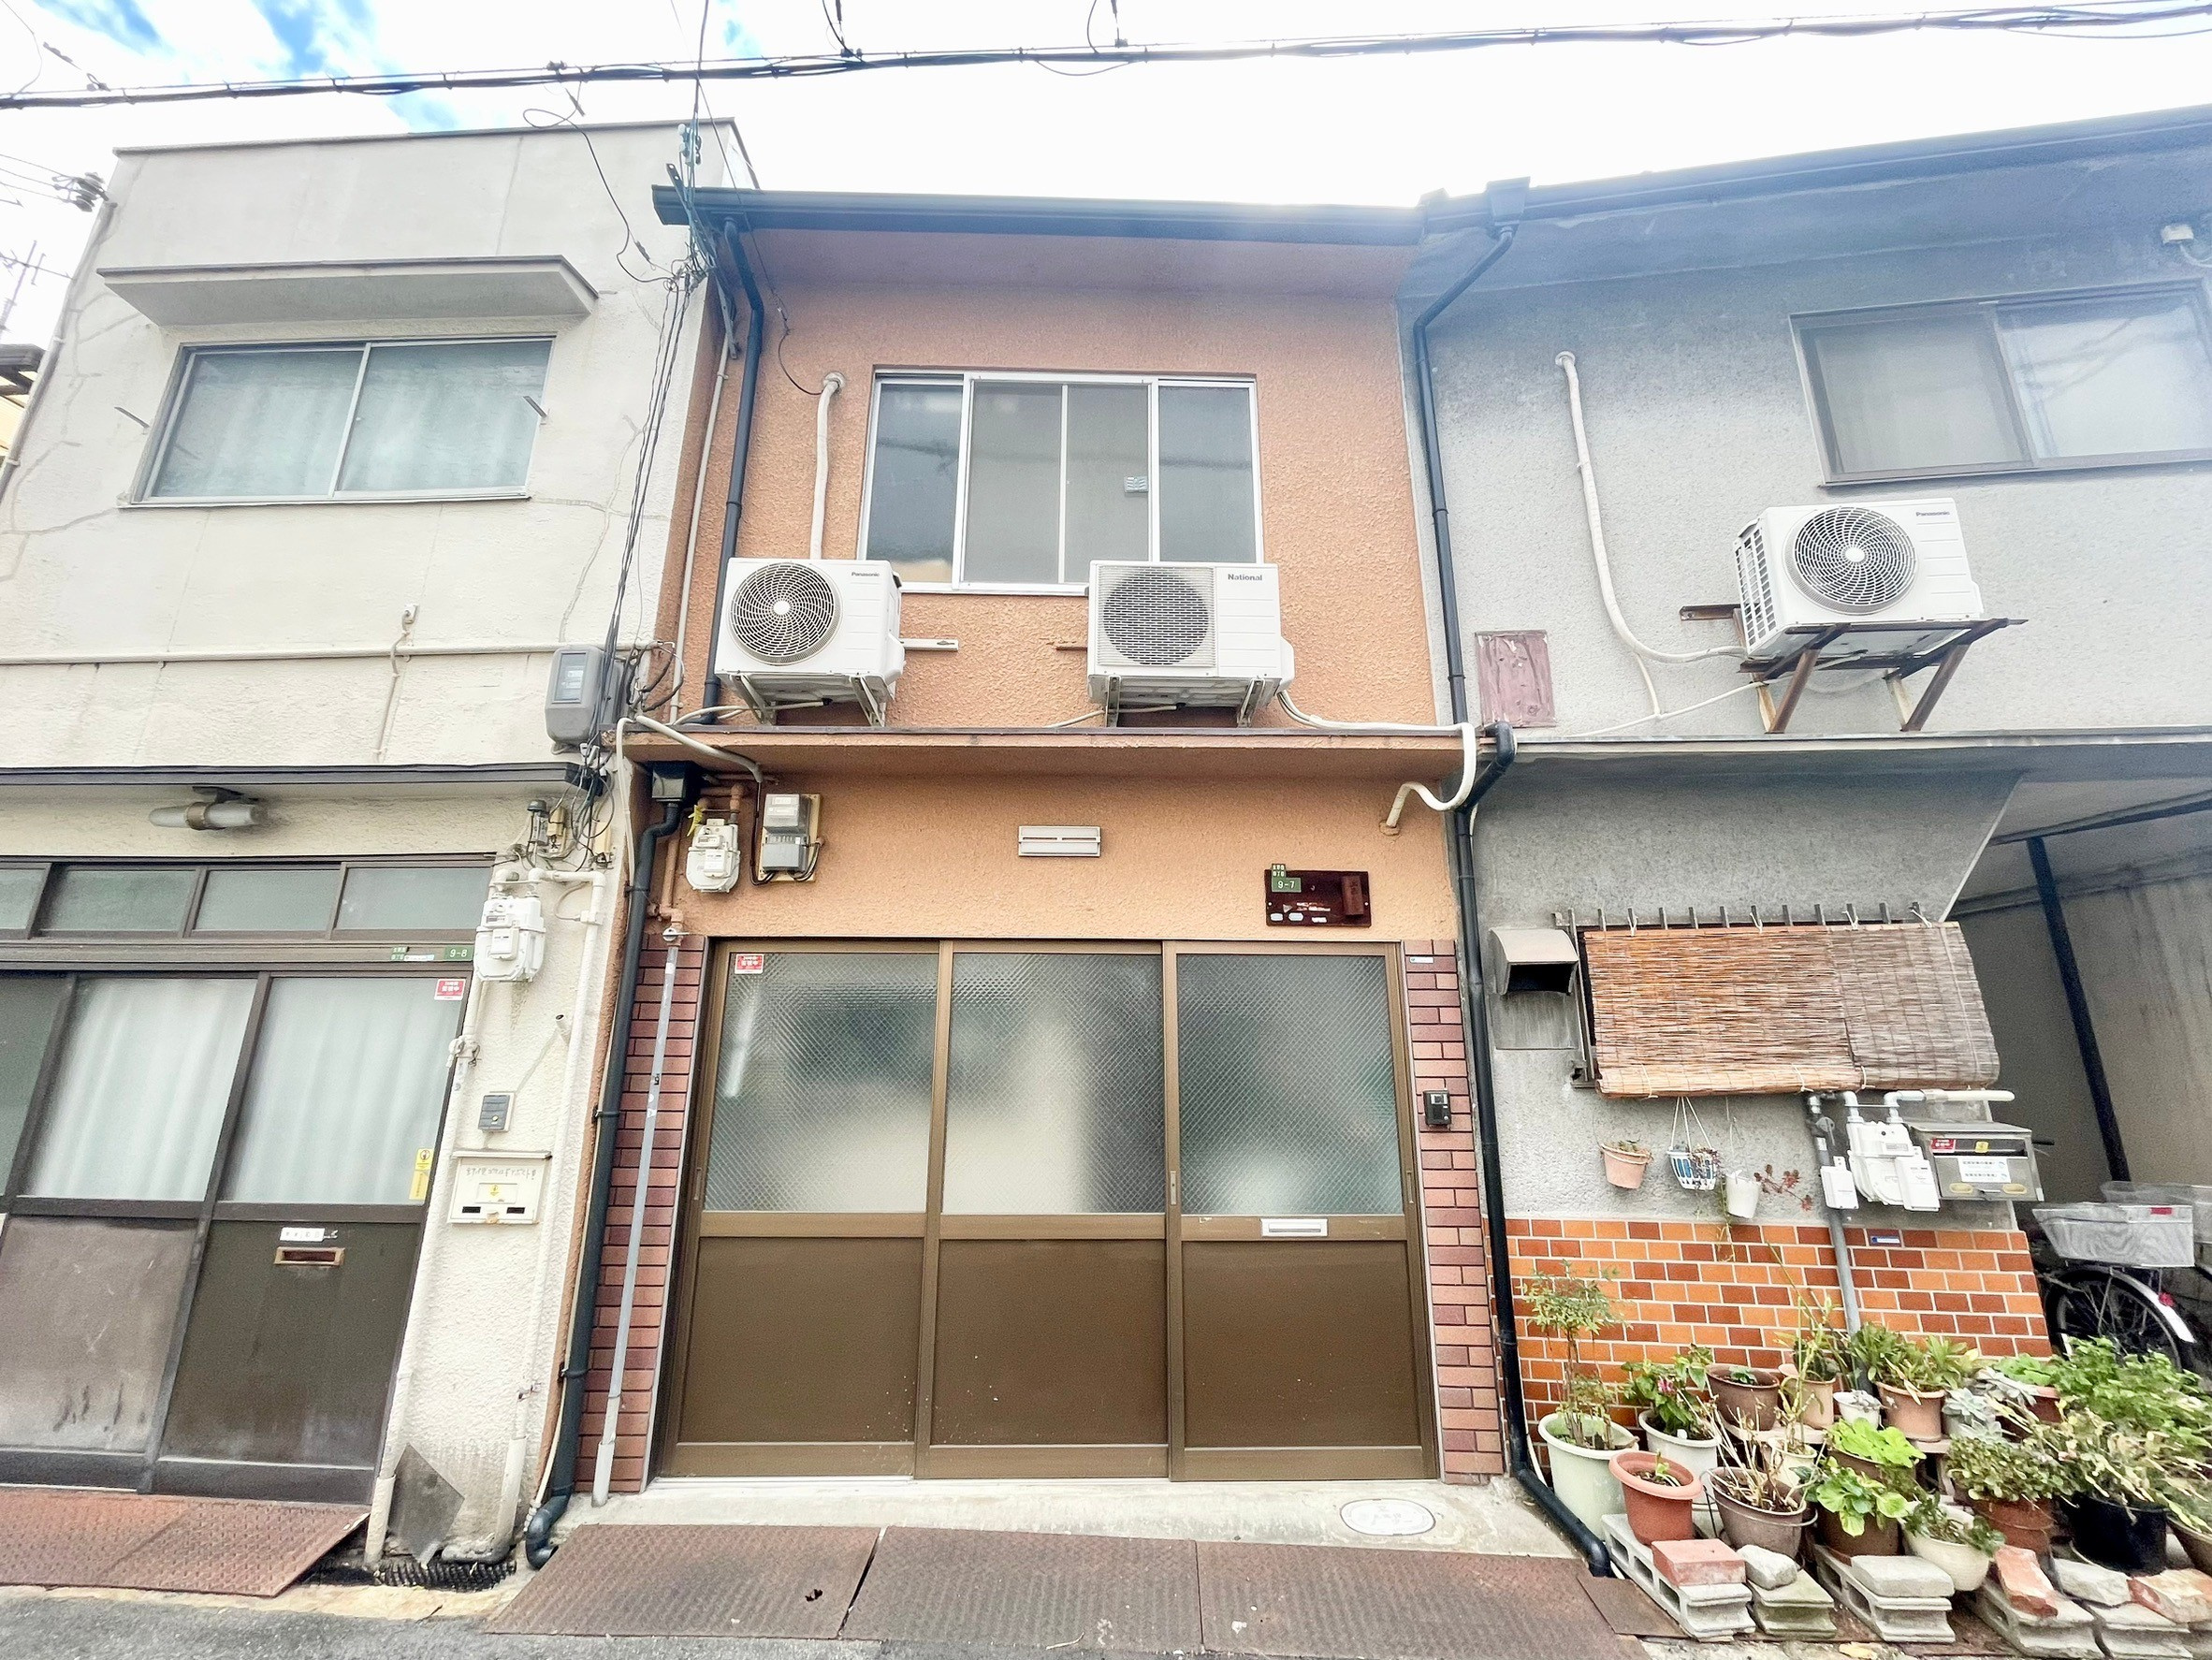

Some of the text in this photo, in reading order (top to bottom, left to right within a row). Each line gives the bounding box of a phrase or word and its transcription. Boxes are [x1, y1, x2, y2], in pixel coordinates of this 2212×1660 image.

[1228, 573, 1263, 581] National
[1277, 880, 1295, 889] 9-7
[449, 948, 468, 958] 9-8
